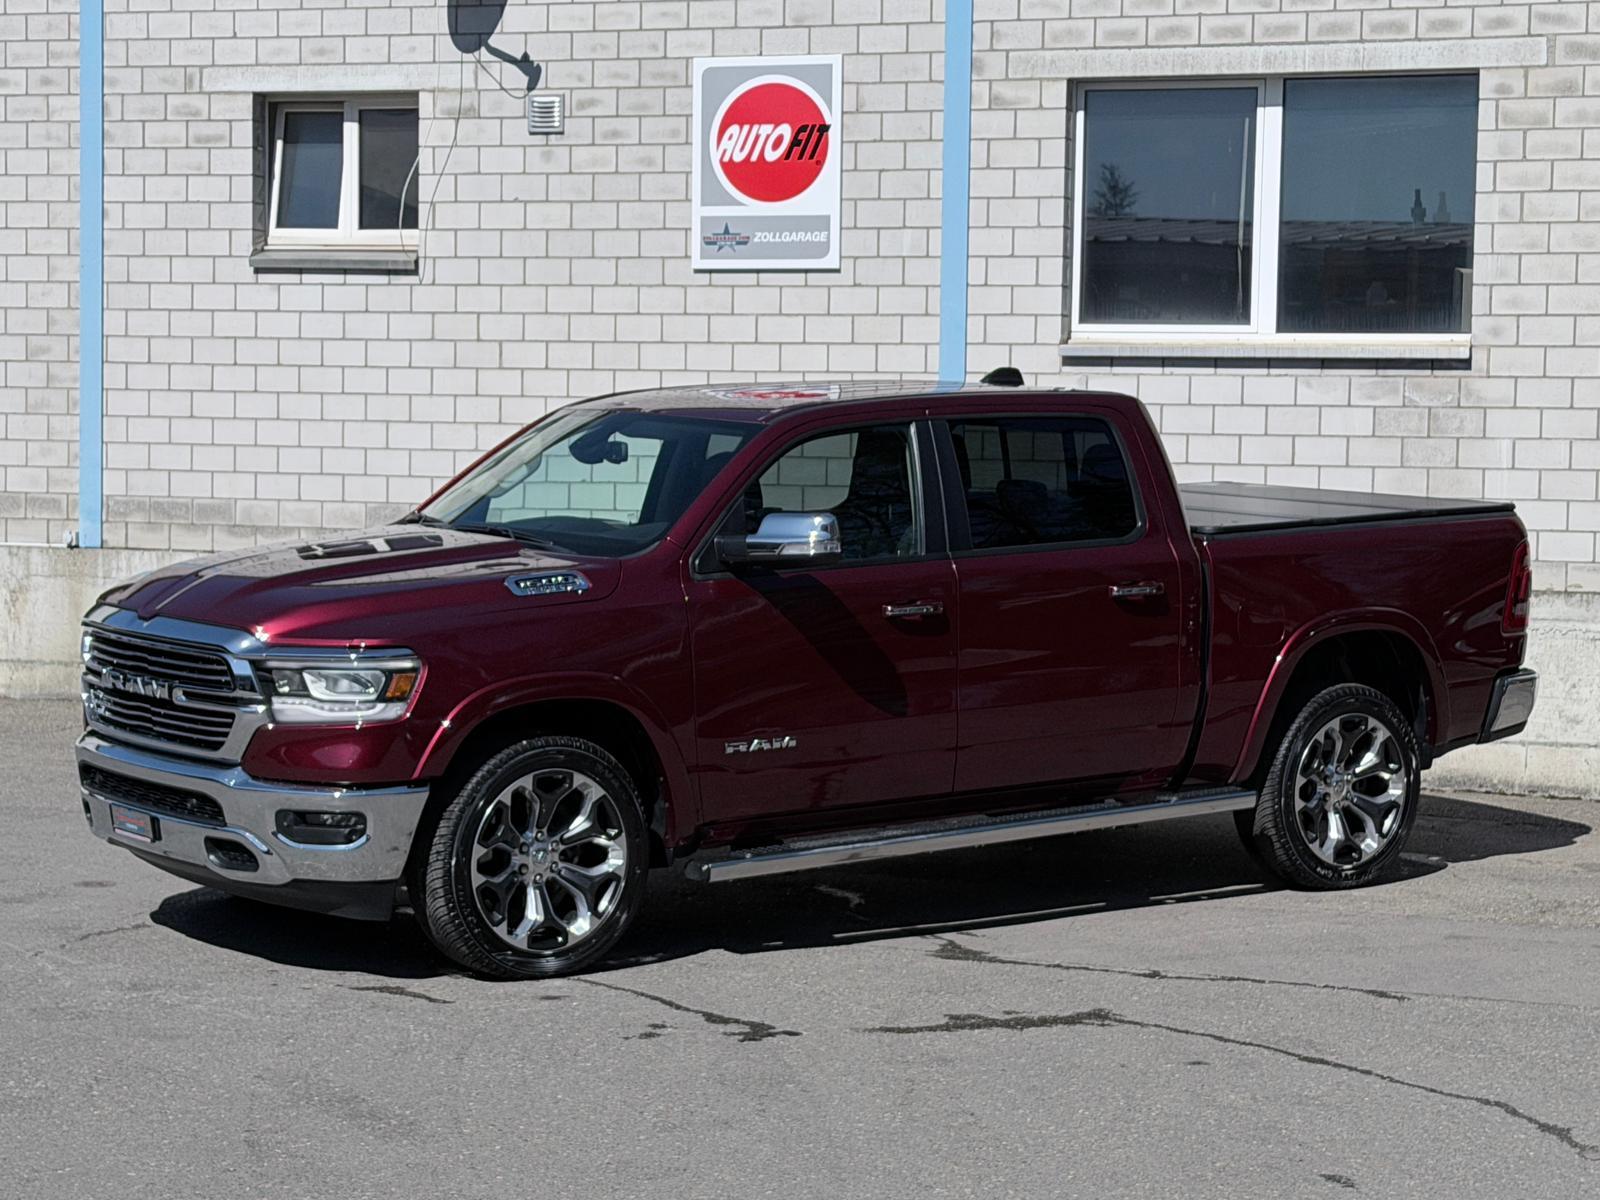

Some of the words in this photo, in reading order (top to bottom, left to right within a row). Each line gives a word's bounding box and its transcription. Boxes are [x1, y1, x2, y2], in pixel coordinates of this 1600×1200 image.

[718, 123, 831, 162] AUTOFIT
[754, 231, 828, 242] ZOLLGARAGE
[101, 667, 169, 699] RAM
[725, 736, 796, 754] RAM
